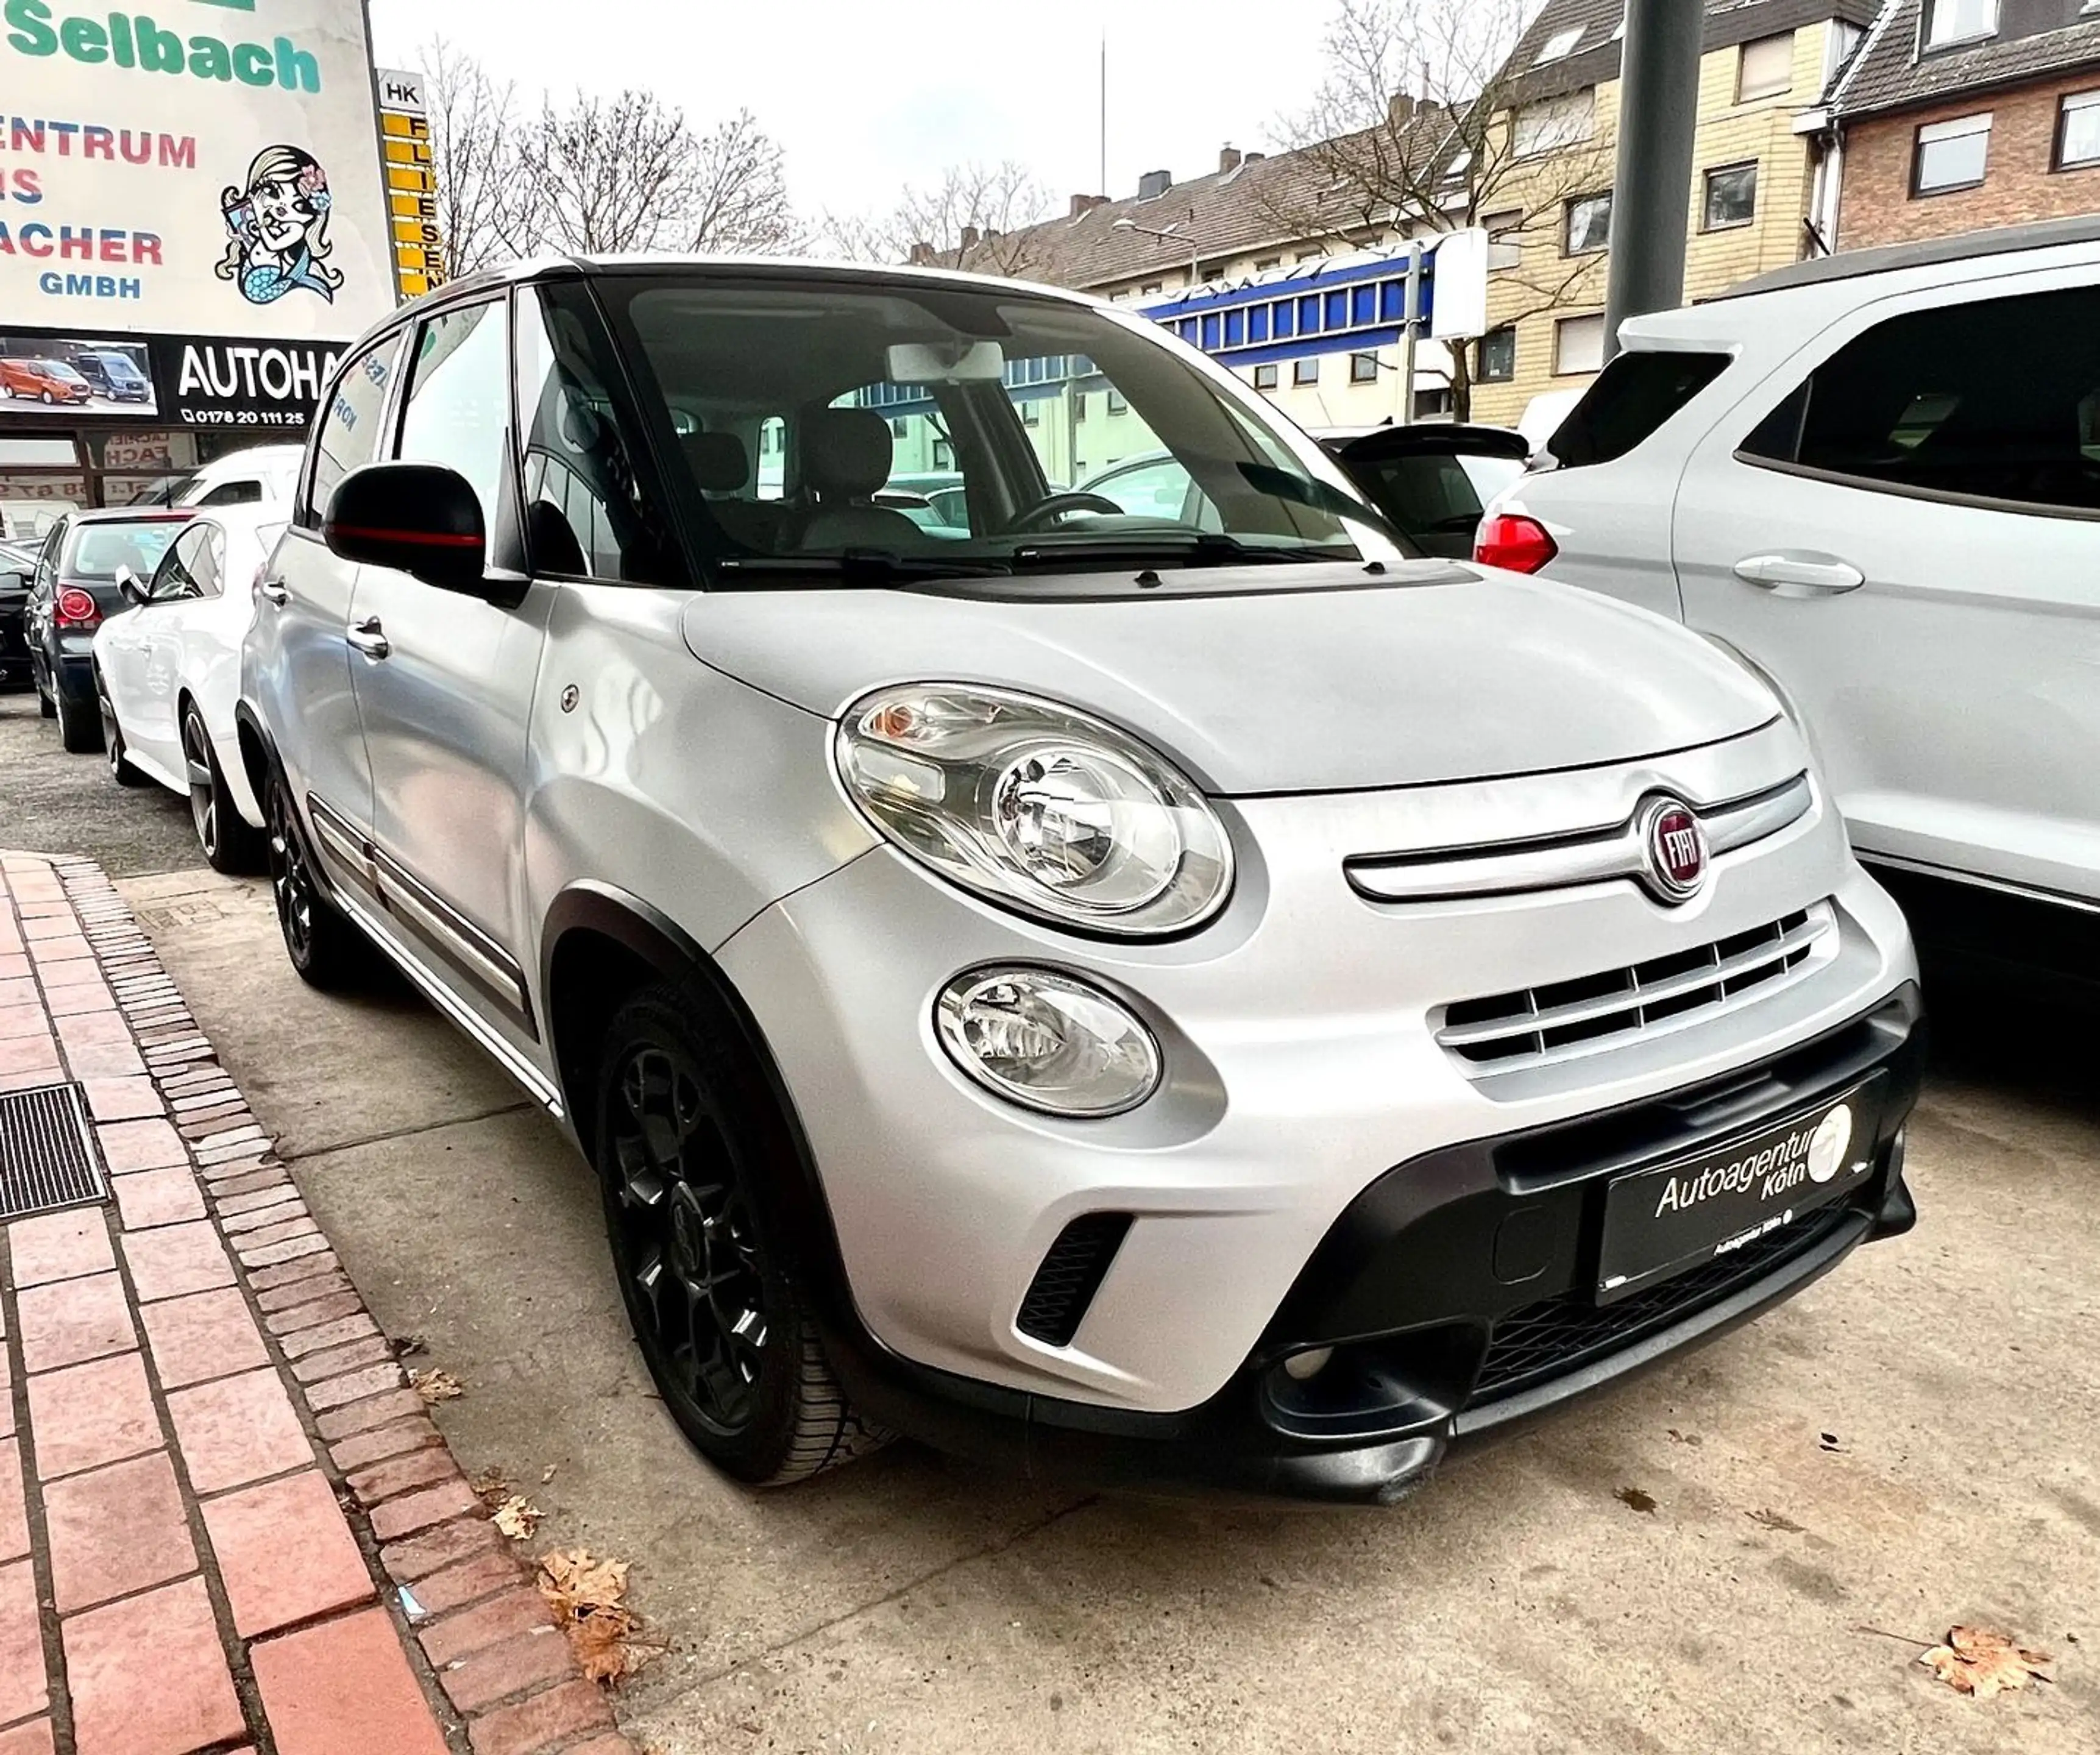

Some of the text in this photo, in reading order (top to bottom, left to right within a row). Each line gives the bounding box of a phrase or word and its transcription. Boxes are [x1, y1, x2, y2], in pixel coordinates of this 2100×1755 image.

[4, 0, 321, 94] Selbach
[386, 83, 420, 105] HK
[0, 115, 196, 169] NTRUM
[39, 272, 140, 299] GMBH
[236, 411, 258, 424] 20
[260, 412, 282, 424] 111
[285, 413, 305, 425] 25
[1664, 828, 1698, 869] FIAT
[1655, 1126, 1817, 1218] Autoagentur
[1761, 1160, 1806, 1200] Köln
